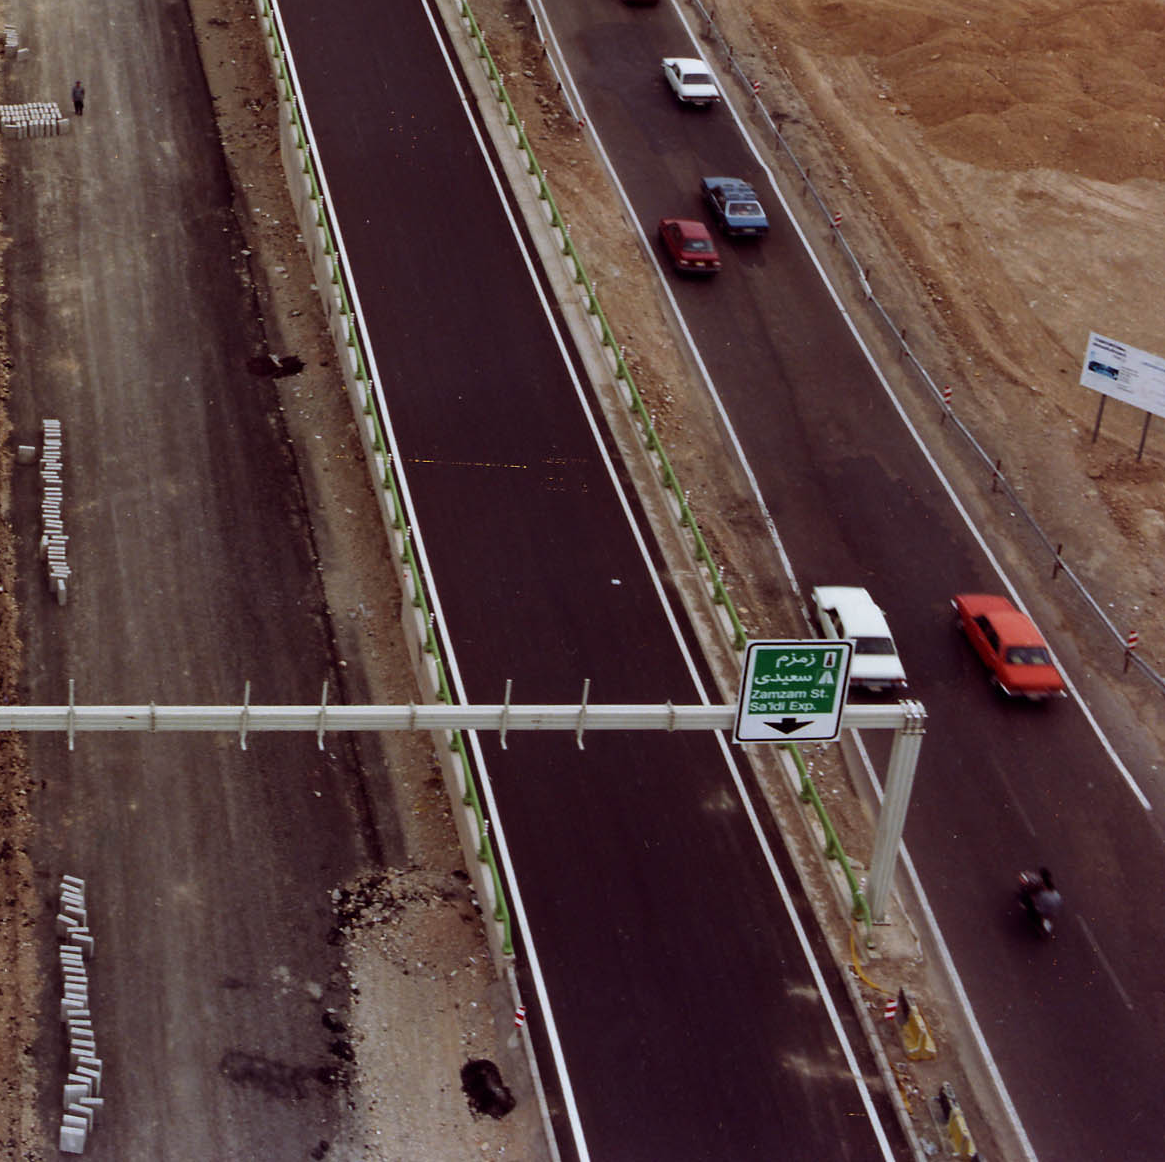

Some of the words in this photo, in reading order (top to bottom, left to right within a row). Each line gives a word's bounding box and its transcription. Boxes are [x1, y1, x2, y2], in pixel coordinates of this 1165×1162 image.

[775, 653, 816, 668] زمزم
[751, 689, 807, 699] Zamzam
[810, 688, 829, 698] St.
